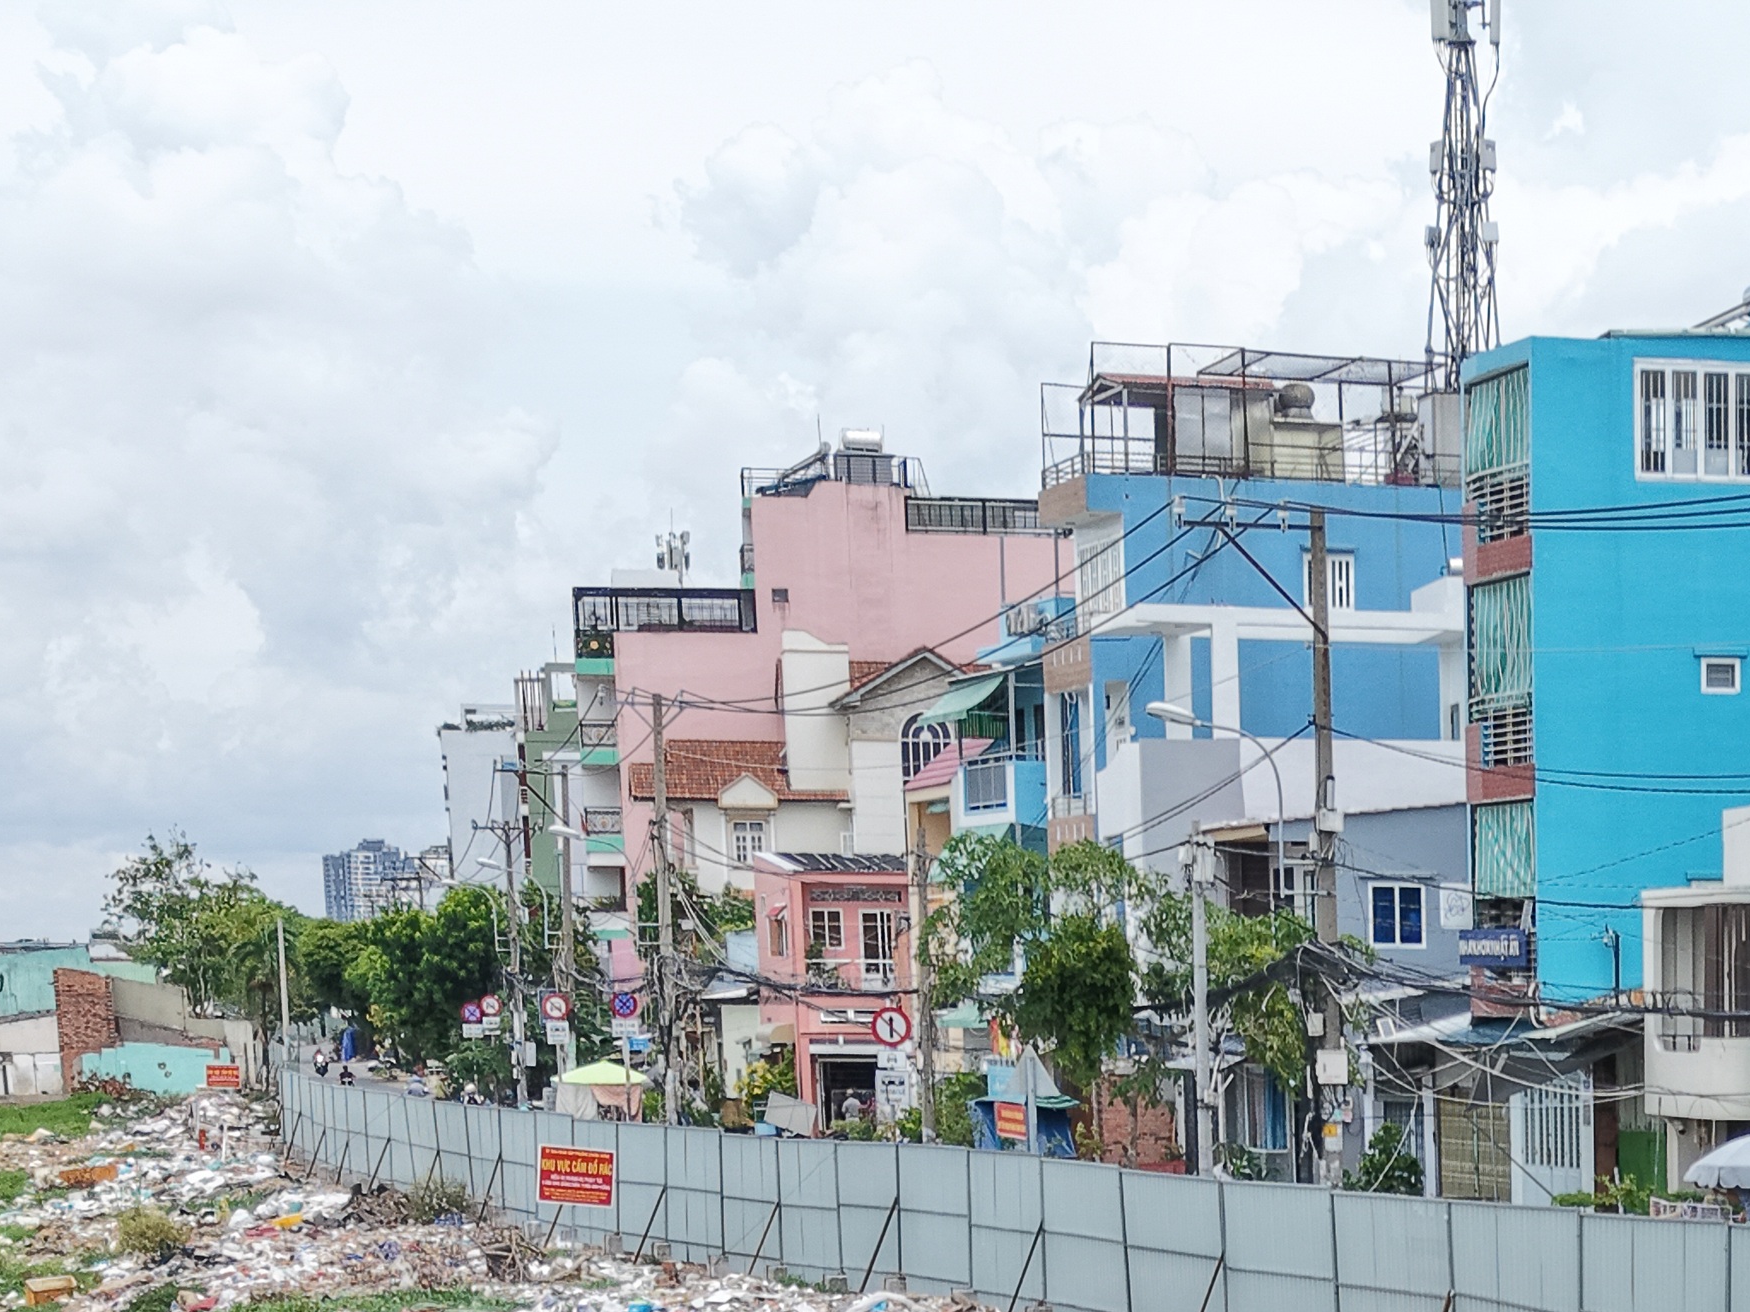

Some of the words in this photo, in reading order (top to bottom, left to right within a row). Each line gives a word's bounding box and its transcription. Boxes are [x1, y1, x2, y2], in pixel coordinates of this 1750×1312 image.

[541, 1158, 555, 1172] KHU
[557, 1159, 570, 1174] VỰC
[572, 1158, 587, 1173] CẤM
[599, 1161, 612, 1176] RÁC
